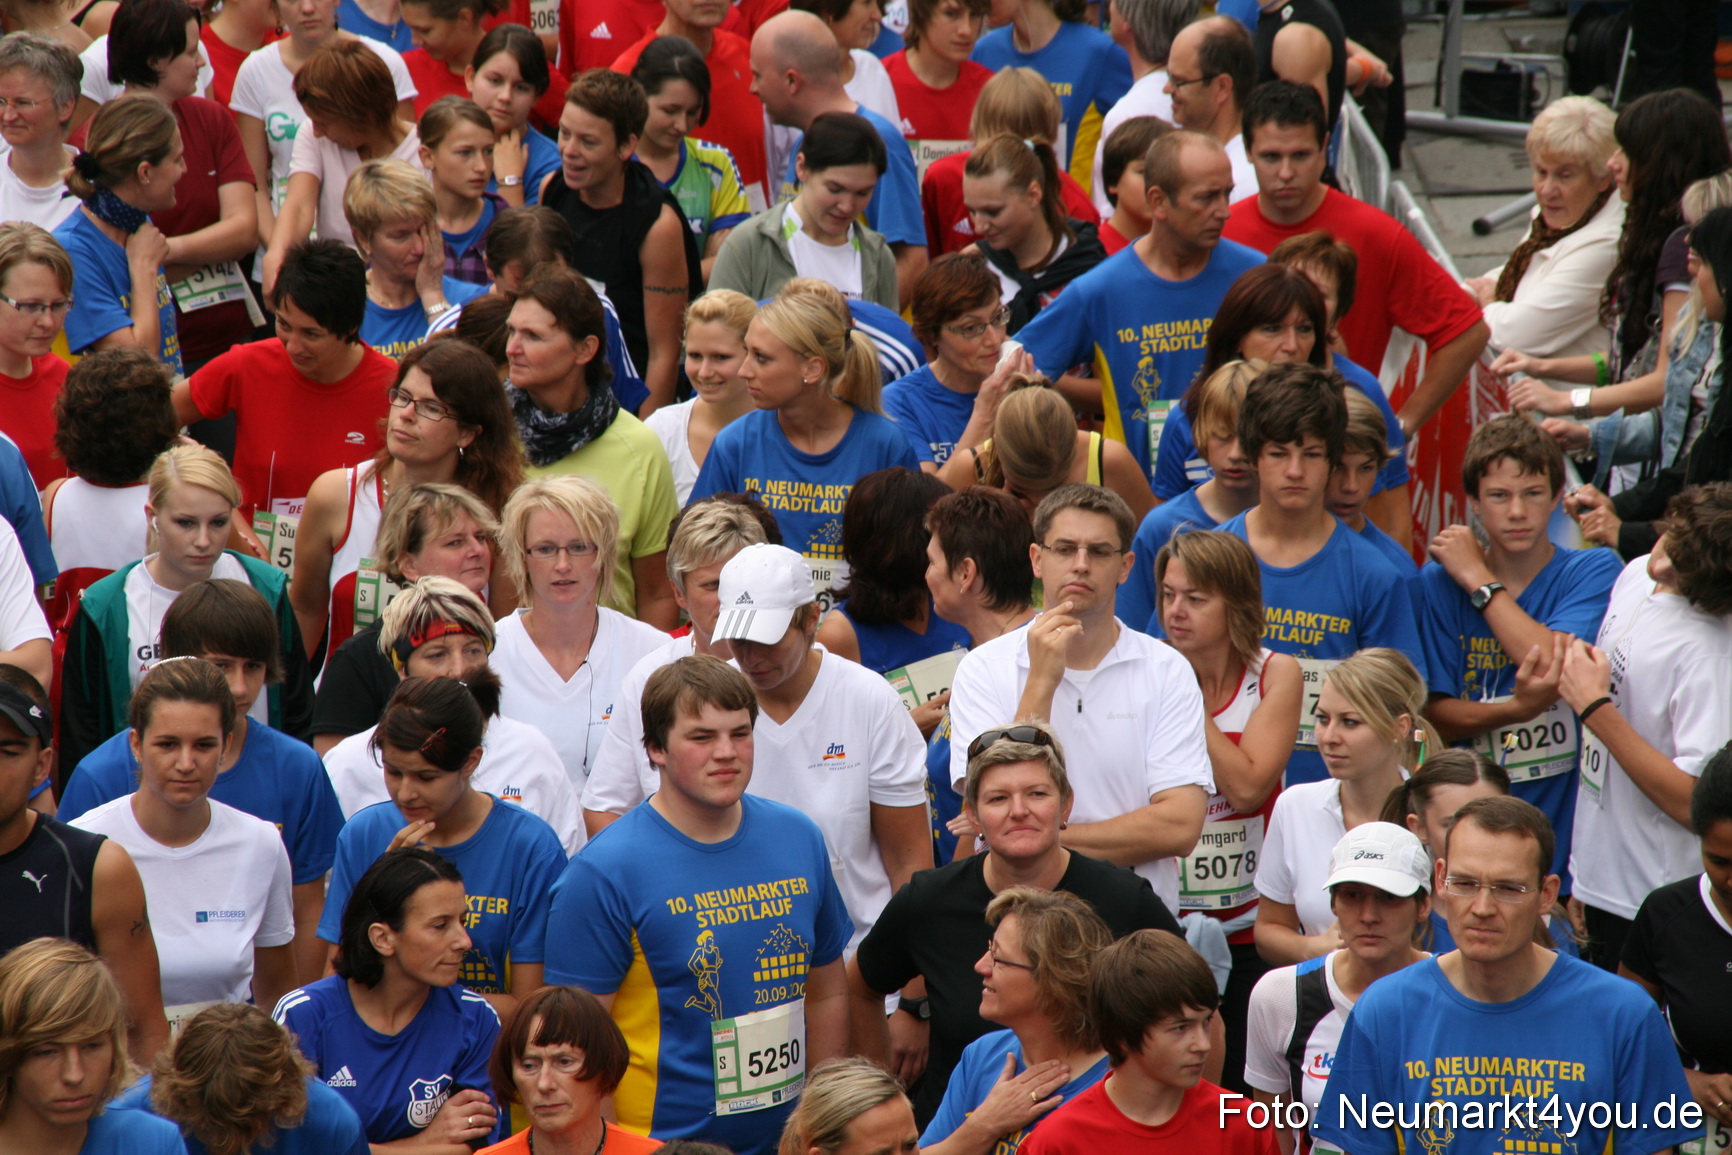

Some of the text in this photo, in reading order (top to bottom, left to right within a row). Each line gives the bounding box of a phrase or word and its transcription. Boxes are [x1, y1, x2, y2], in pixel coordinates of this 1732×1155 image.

[1116, 328, 1140, 343] 10.
[359, 589, 367, 602] S
[826, 742, 845, 755] dm
[1501, 720, 1567, 754] 5020
[502, 784, 521, 796] dm
[1201, 824, 1247, 848] mgard
[1194, 850, 1257, 881] 5078
[666, 877, 810, 916] 10. NEUMARKTER
[695, 897, 793, 929] STADTLAUF
[719, 1055, 727, 1070] S
[748, 1038, 800, 1078] 5250
[1405, 1056, 1586, 1082] 10. NEUMARKTER
[326, 1078, 357, 1088] adidas
[424, 1083, 441, 1100] SV
[1430, 1076, 1555, 1099] STADTLAUF
